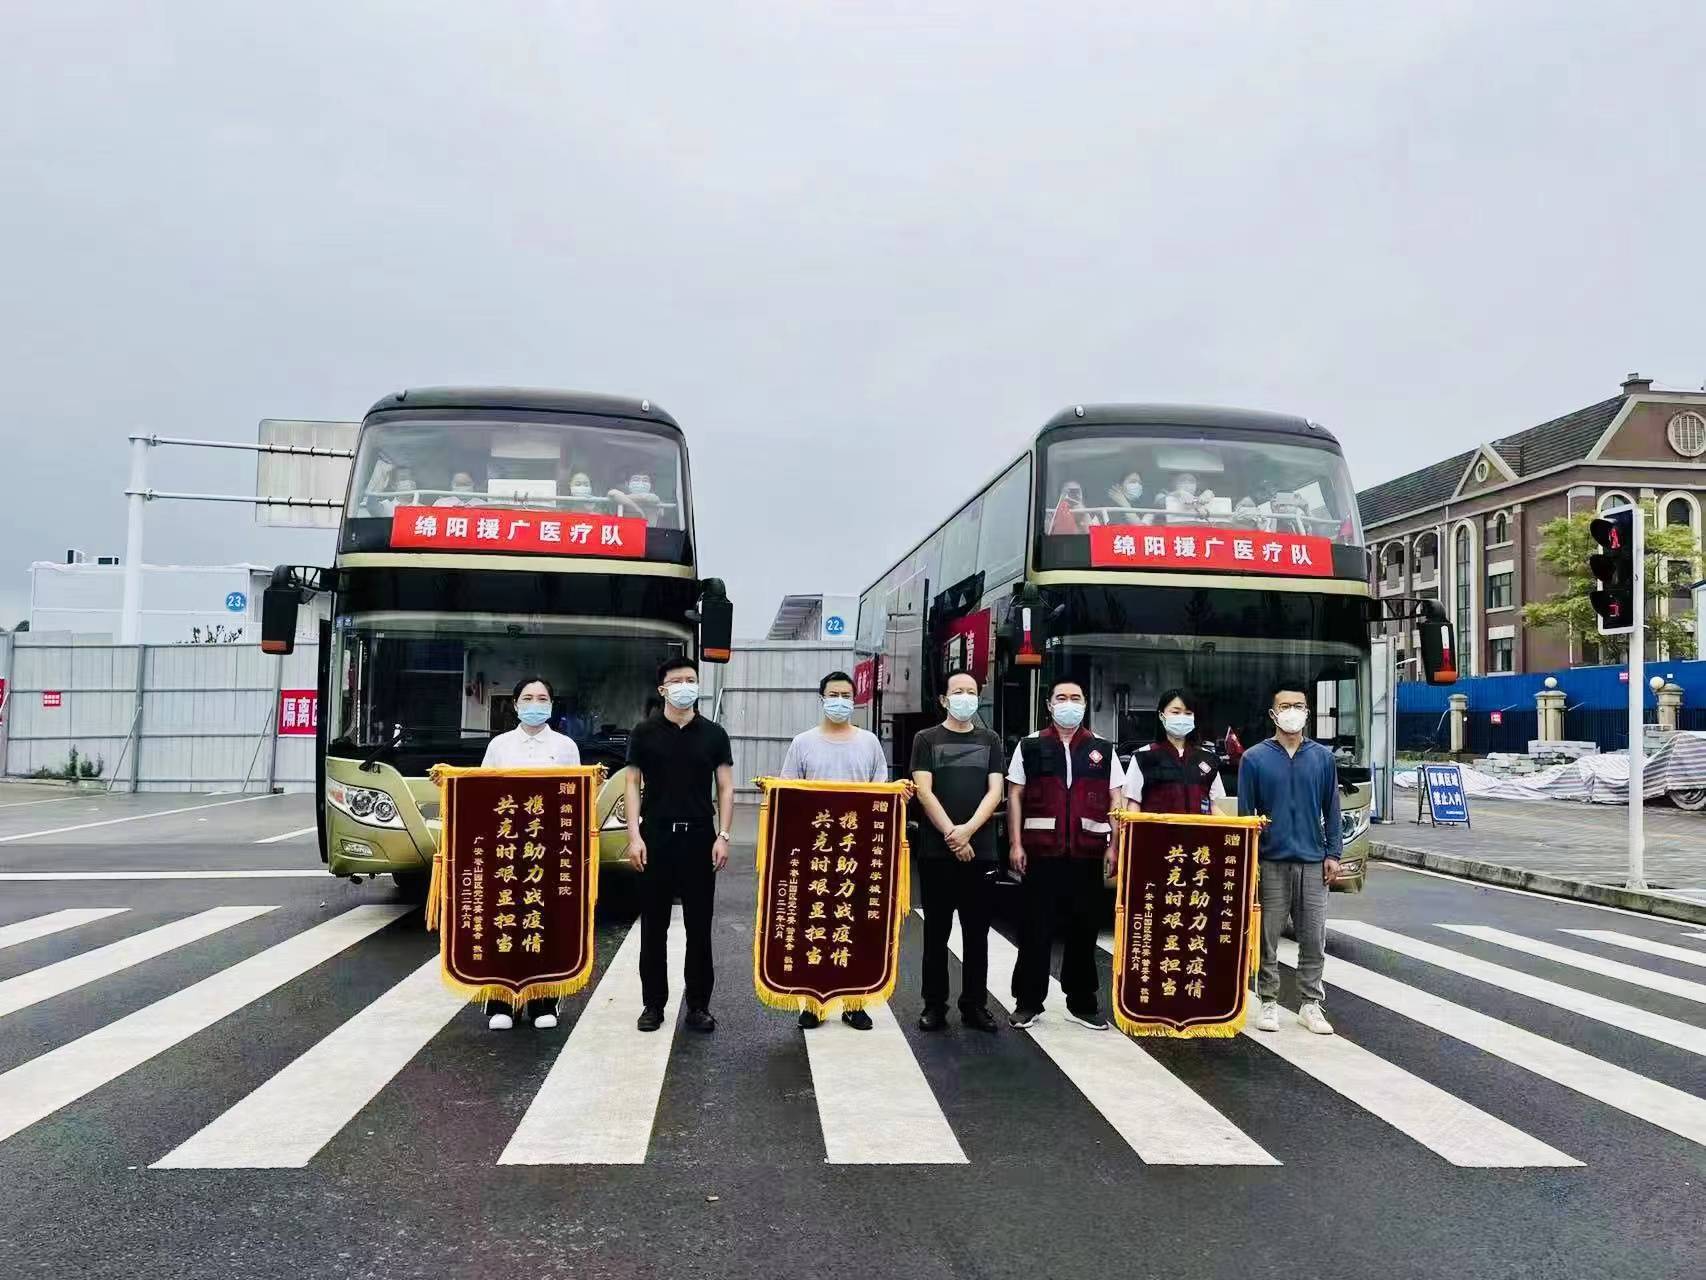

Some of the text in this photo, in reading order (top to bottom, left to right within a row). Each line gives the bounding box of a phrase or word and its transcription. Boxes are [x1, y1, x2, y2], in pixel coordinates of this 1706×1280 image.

[414, 515, 624, 547] 绵阳援广医疗队
[1113, 535, 1313, 566] 绵阳援广医疗队
[493, 795, 519, 953] 共克时艰显担当
[522, 795, 545, 953] 携手助力战疫情
[558, 804, 574, 896] 绵阳市人民医院
[804, 809, 835, 966] 共克时艰显担当
[830, 811, 858, 968] 携手助力战疫情
[867, 821, 885, 920] 四川省科学城医院
[1160, 844, 1188, 997] 共克时艰显担当
[1184, 846, 1212, 999] 携手助力战疫情
[1219, 855, 1237, 944] 绵阳市中心医院
